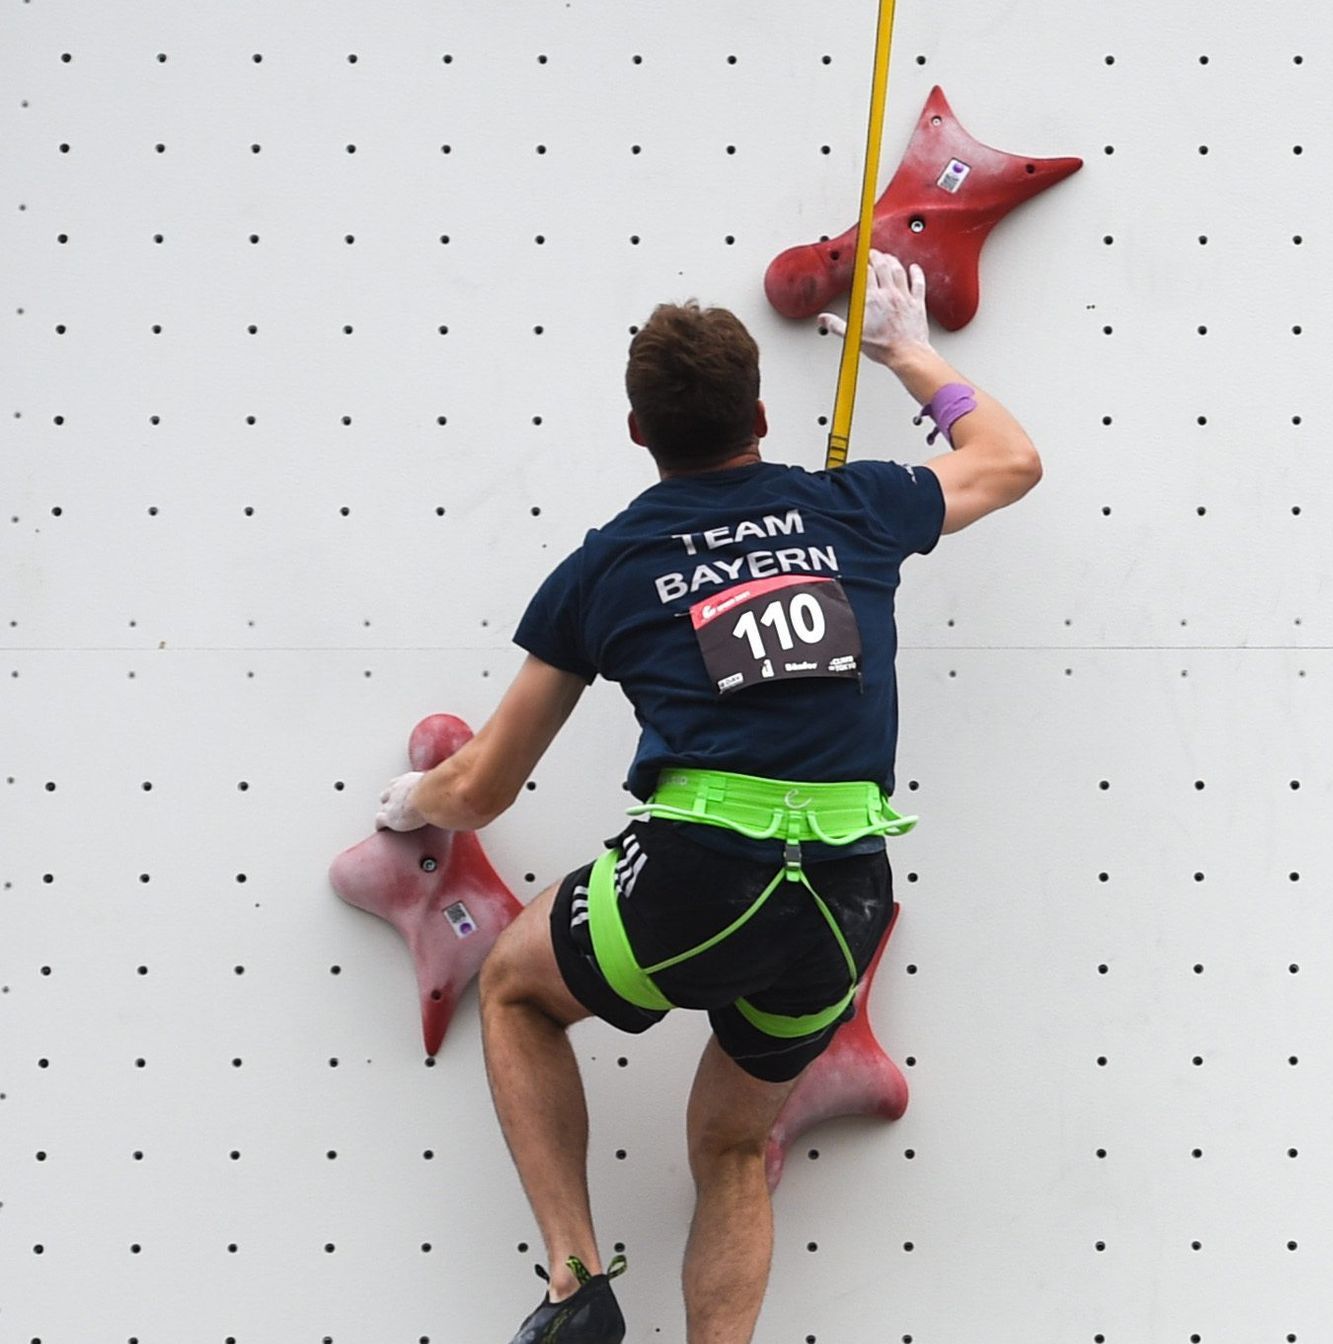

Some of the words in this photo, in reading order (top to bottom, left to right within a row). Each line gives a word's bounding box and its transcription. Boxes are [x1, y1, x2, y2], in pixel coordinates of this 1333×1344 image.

[671, 509, 805, 556] TEAM
[654, 545, 839, 604] BAYERN
[732, 592, 826, 660] 110
